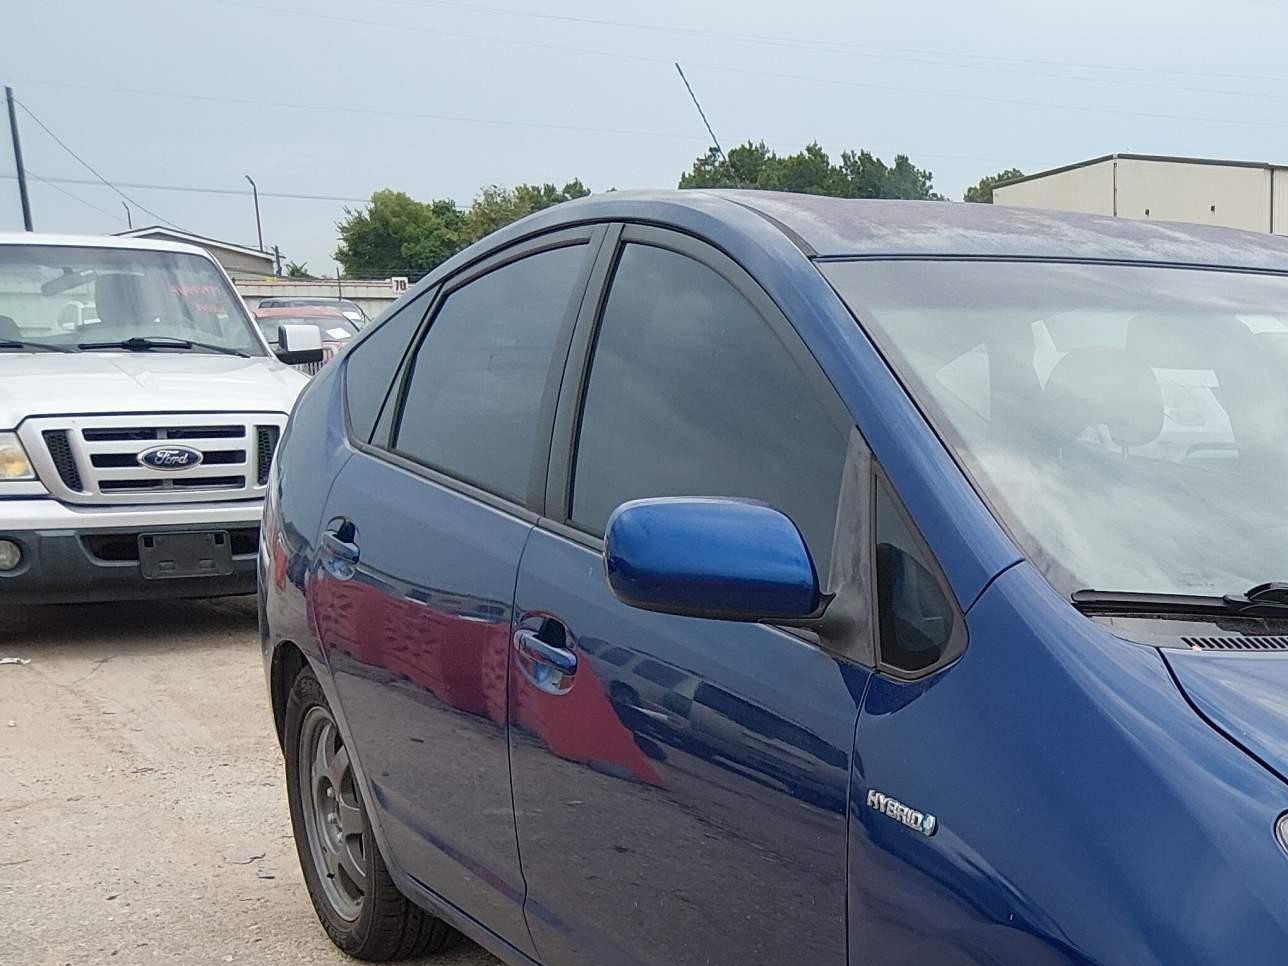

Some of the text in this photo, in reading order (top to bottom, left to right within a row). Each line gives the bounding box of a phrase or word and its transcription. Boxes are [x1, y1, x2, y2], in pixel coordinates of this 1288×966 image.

[393, 279, 407, 291] 70
[154, 450, 189, 465] Ford
[866, 789, 924, 831] HYBRID
